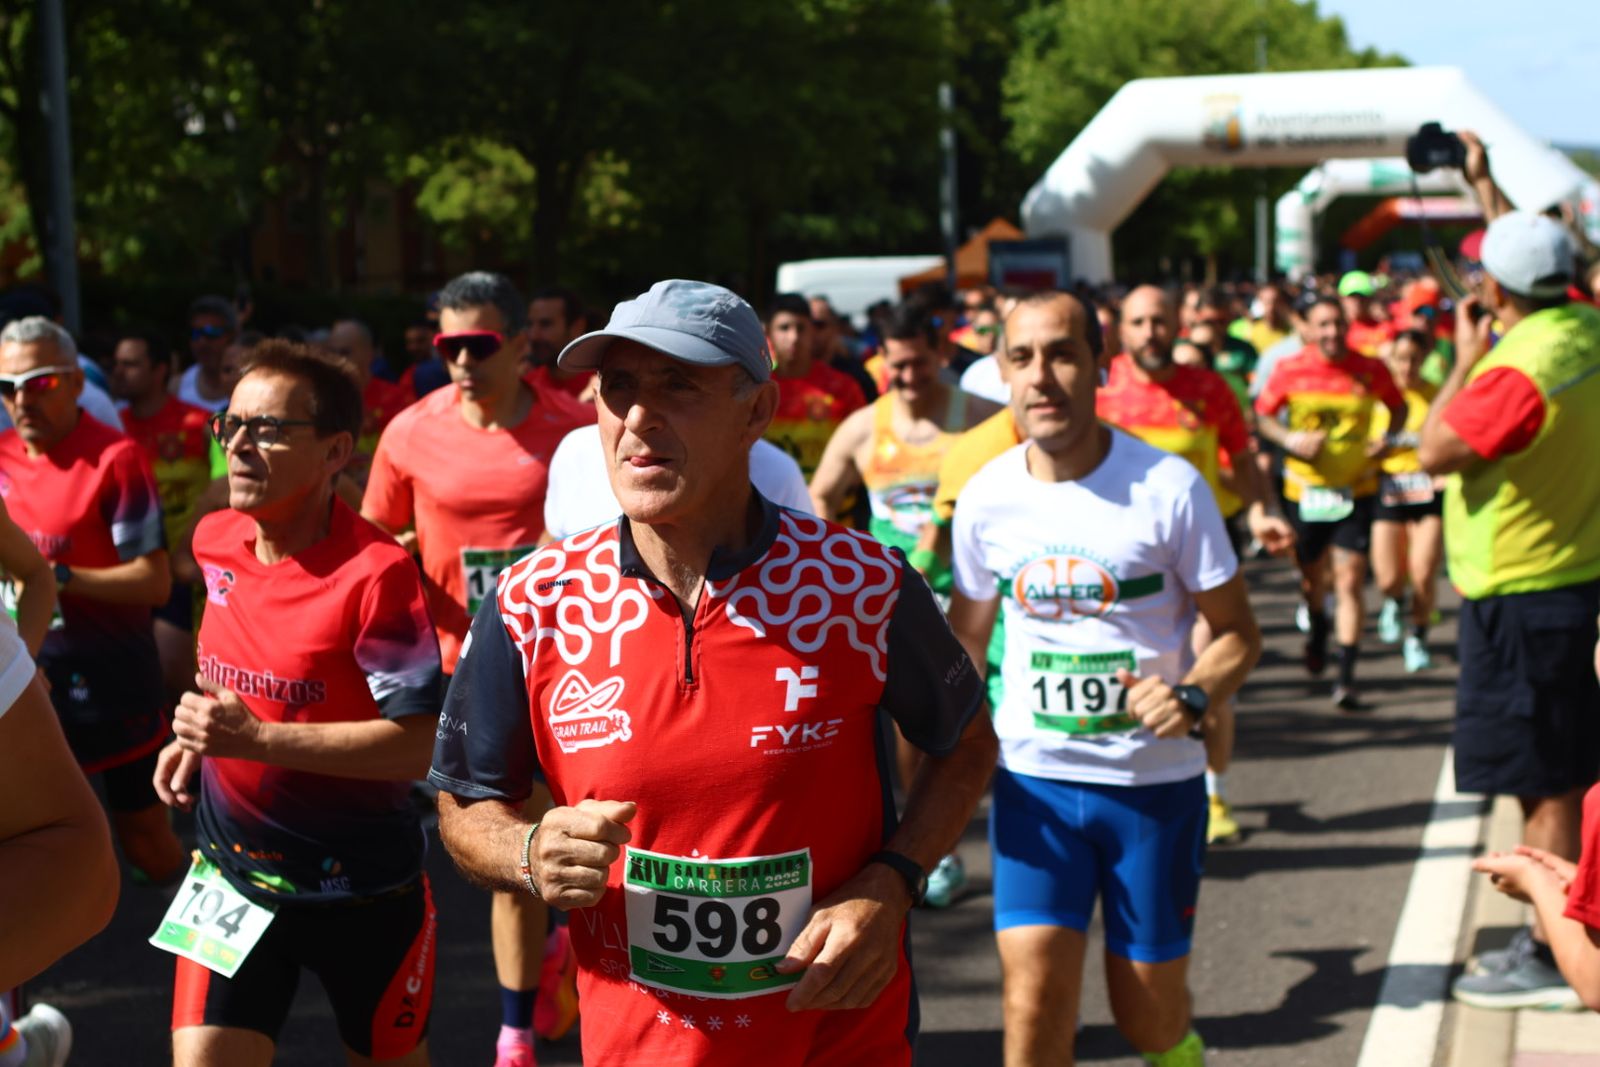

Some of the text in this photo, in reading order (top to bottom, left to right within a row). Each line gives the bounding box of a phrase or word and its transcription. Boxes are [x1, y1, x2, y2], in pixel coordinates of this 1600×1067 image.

[1032, 675, 1129, 713] 1197
[750, 718, 843, 748] FYKE
[629, 855, 669, 887] XIV
[674, 863, 704, 878] SAN
[674, 876, 760, 893] CARRERA
[180, 882, 251, 938] 794
[652, 895, 782, 959] 598
